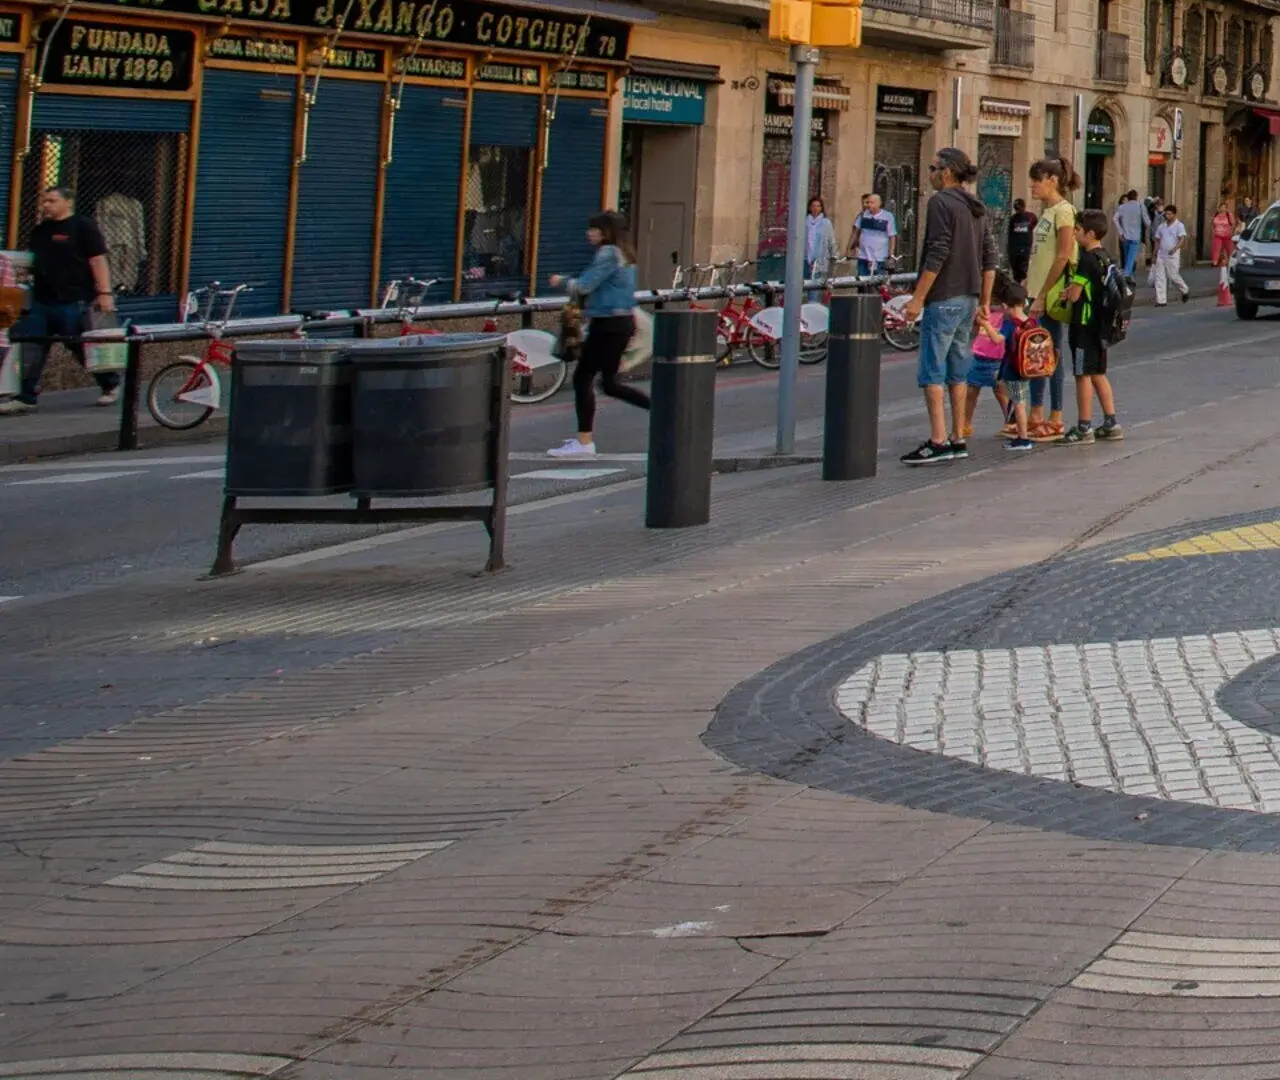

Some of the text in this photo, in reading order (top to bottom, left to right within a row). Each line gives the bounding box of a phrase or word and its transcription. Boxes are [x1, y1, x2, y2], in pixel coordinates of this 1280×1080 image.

[70, 25, 171, 56] FUNDADA
[599, 35, 616, 57] 78
[622, 75, 703, 100] TERNACIONAL
